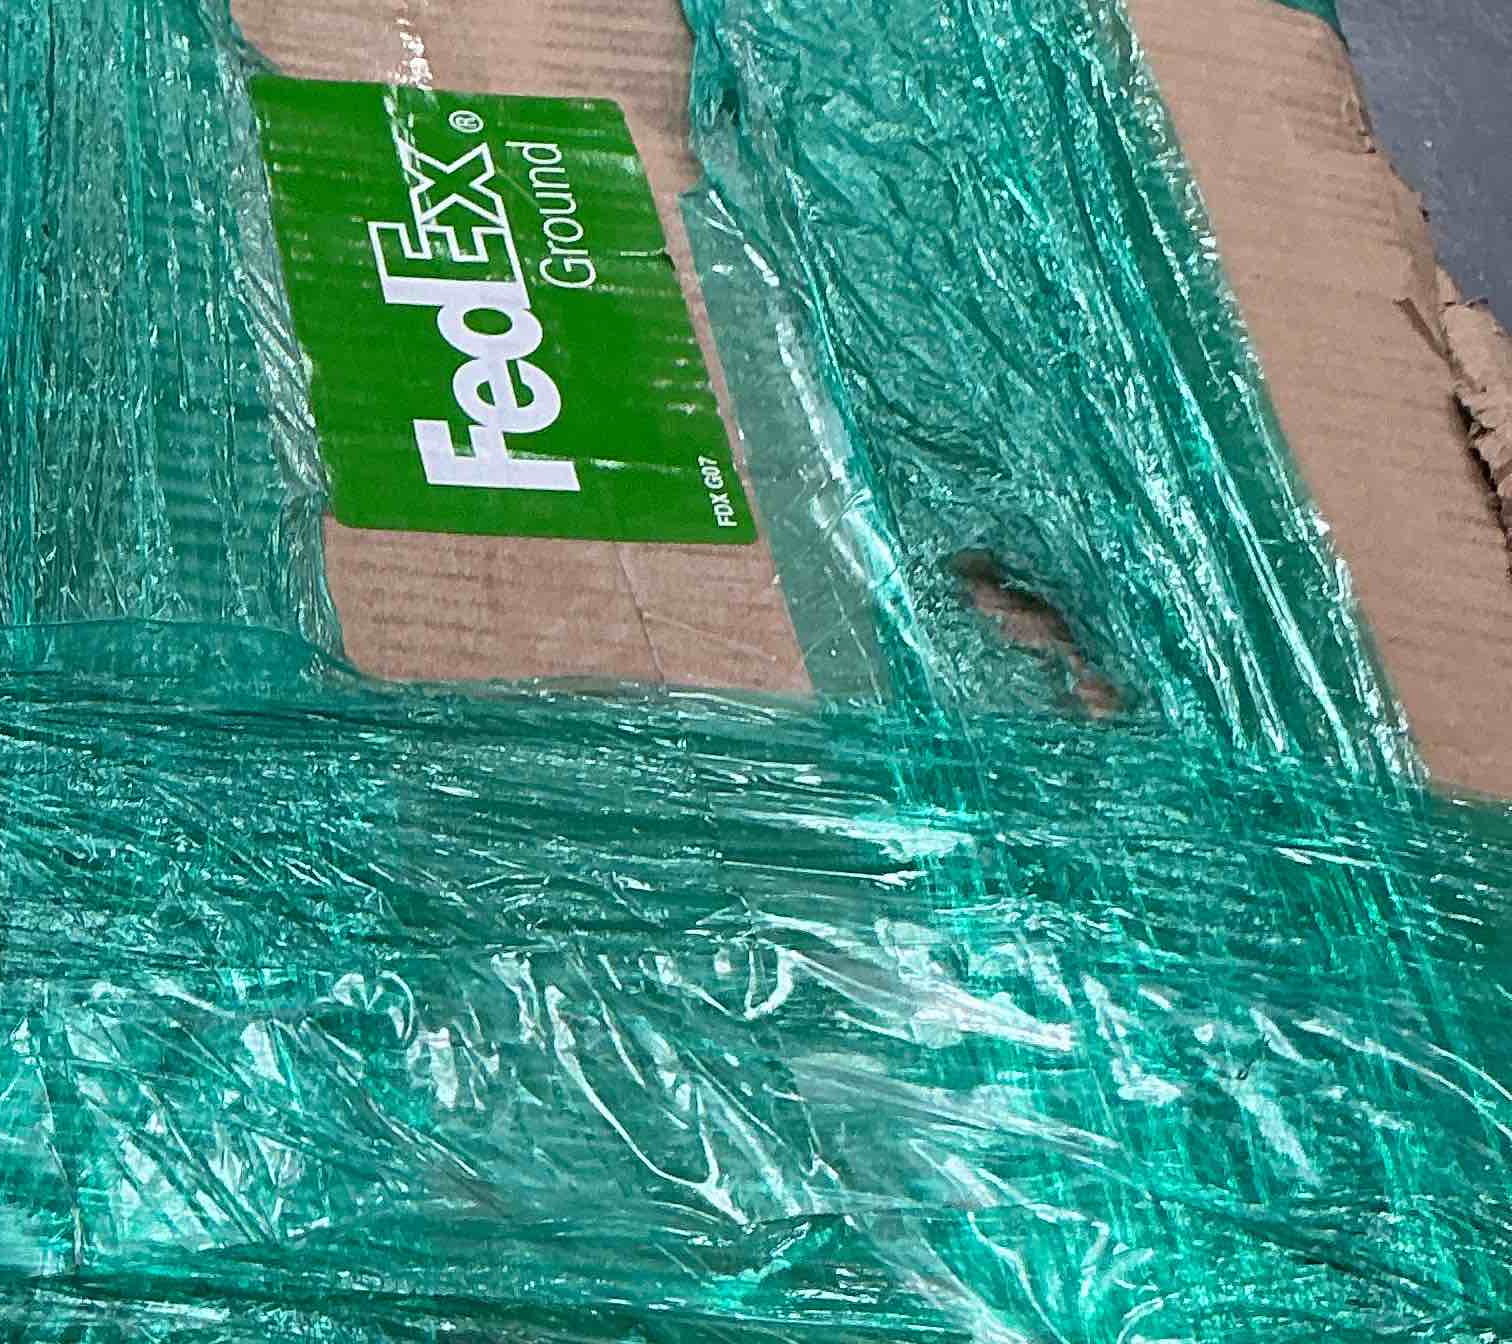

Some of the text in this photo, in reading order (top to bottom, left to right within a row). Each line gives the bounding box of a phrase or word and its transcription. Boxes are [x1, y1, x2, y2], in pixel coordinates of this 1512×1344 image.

[504, 141, 597, 290] Ground
[367, 139, 582, 492] FedEx
[697, 455, 738, 527] FDX G07
